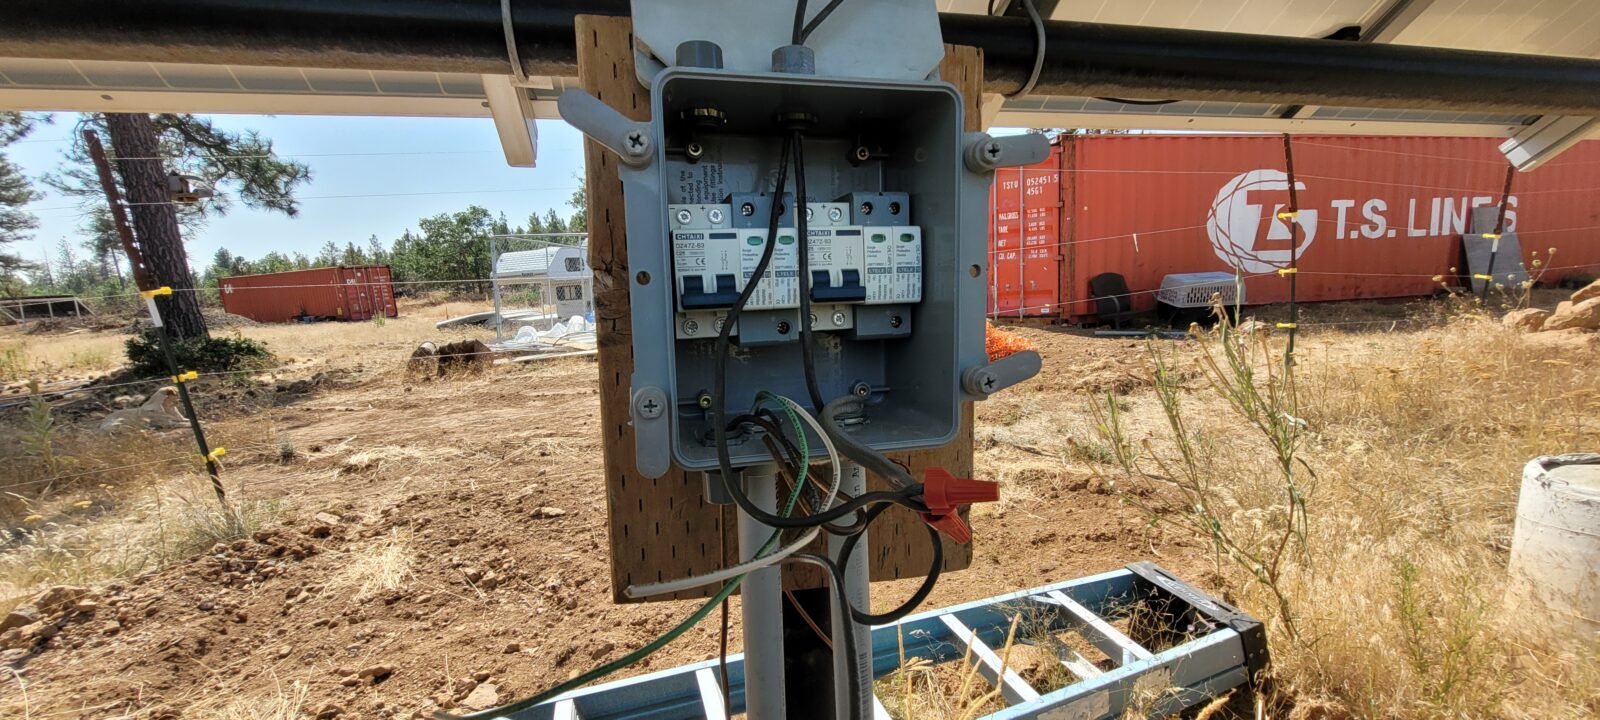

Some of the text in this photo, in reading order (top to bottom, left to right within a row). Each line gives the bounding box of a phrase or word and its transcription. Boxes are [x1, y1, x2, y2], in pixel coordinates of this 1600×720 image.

[1003, 180, 1018, 190] TSTU
[1026, 176, 1051, 186] 052451
[1026, 186, 1043, 196] 45G1
[1331, 198, 1396, 239] T.S.
